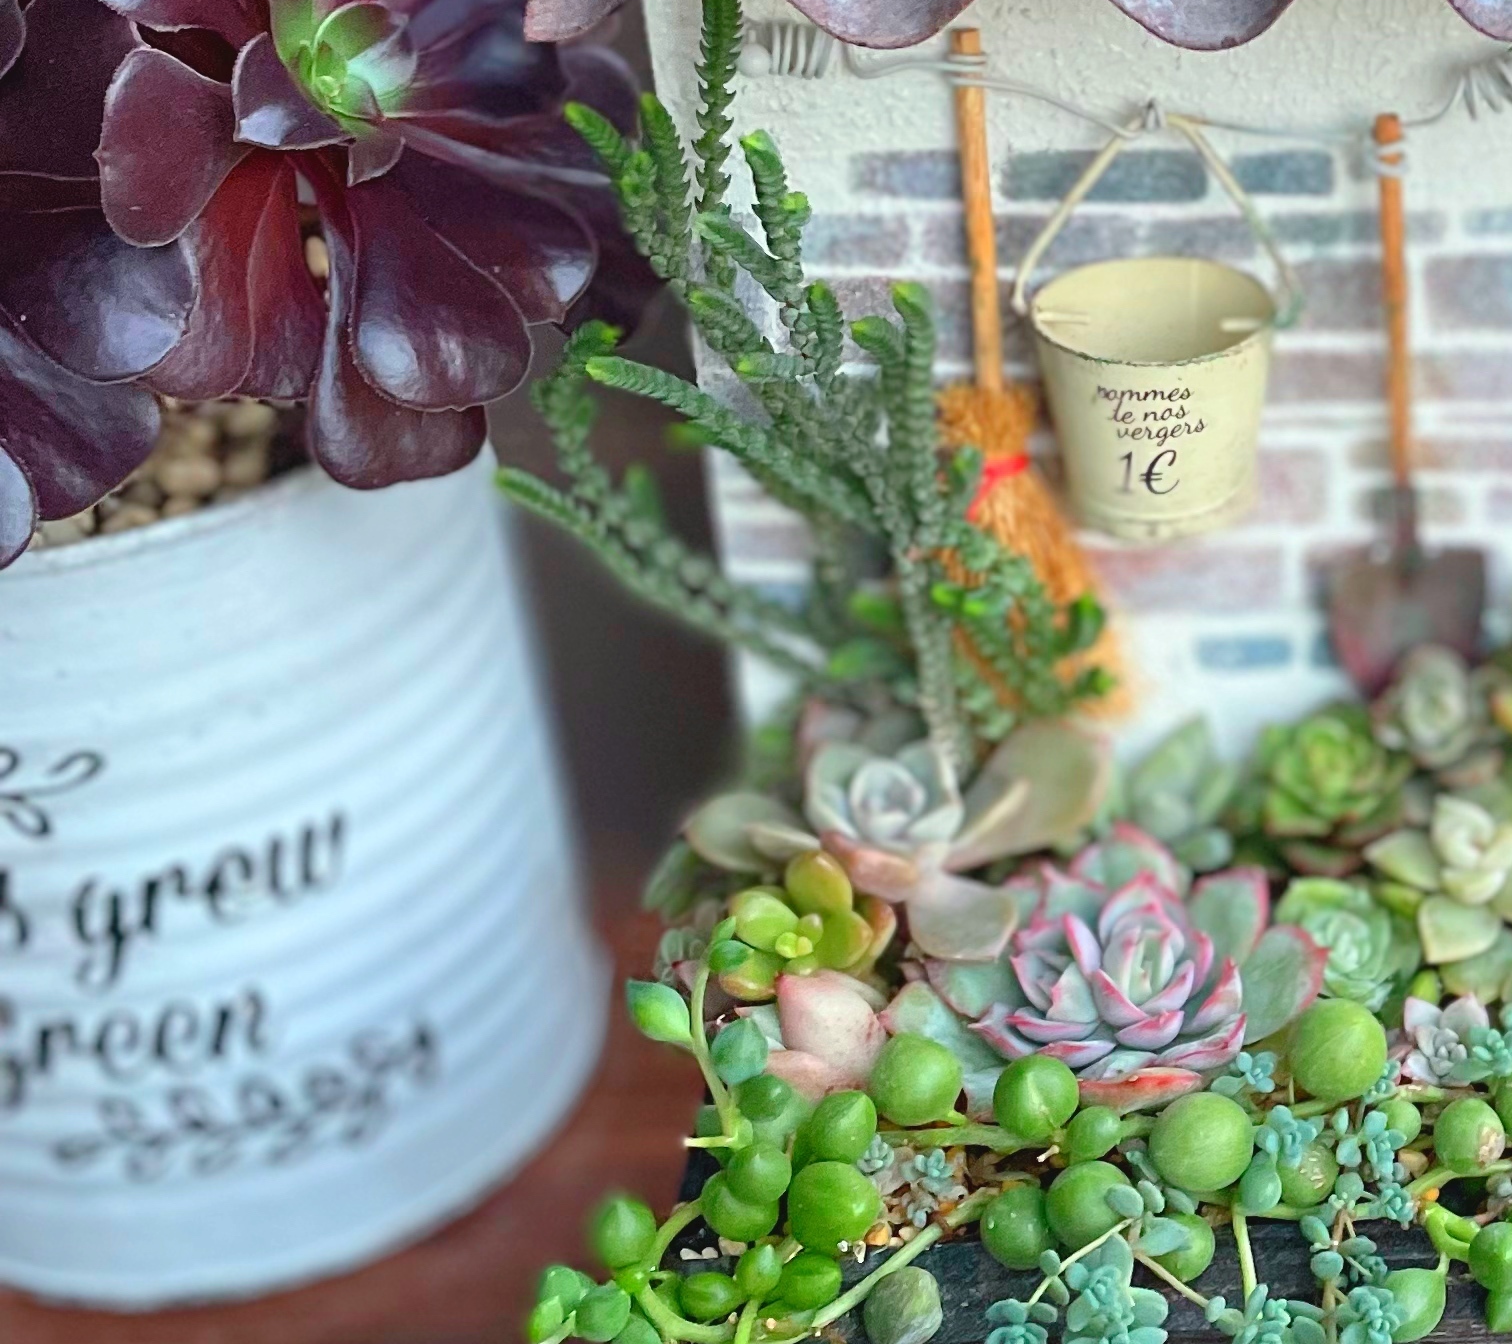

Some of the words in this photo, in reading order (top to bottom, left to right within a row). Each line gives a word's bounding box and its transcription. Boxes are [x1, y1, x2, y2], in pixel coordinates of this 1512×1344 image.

[1143, 405, 1190, 422] nos
[1117, 418, 1207, 447] vergers
[1116, 449, 1180, 495] 1€
[70, 811, 345, 990] grow
